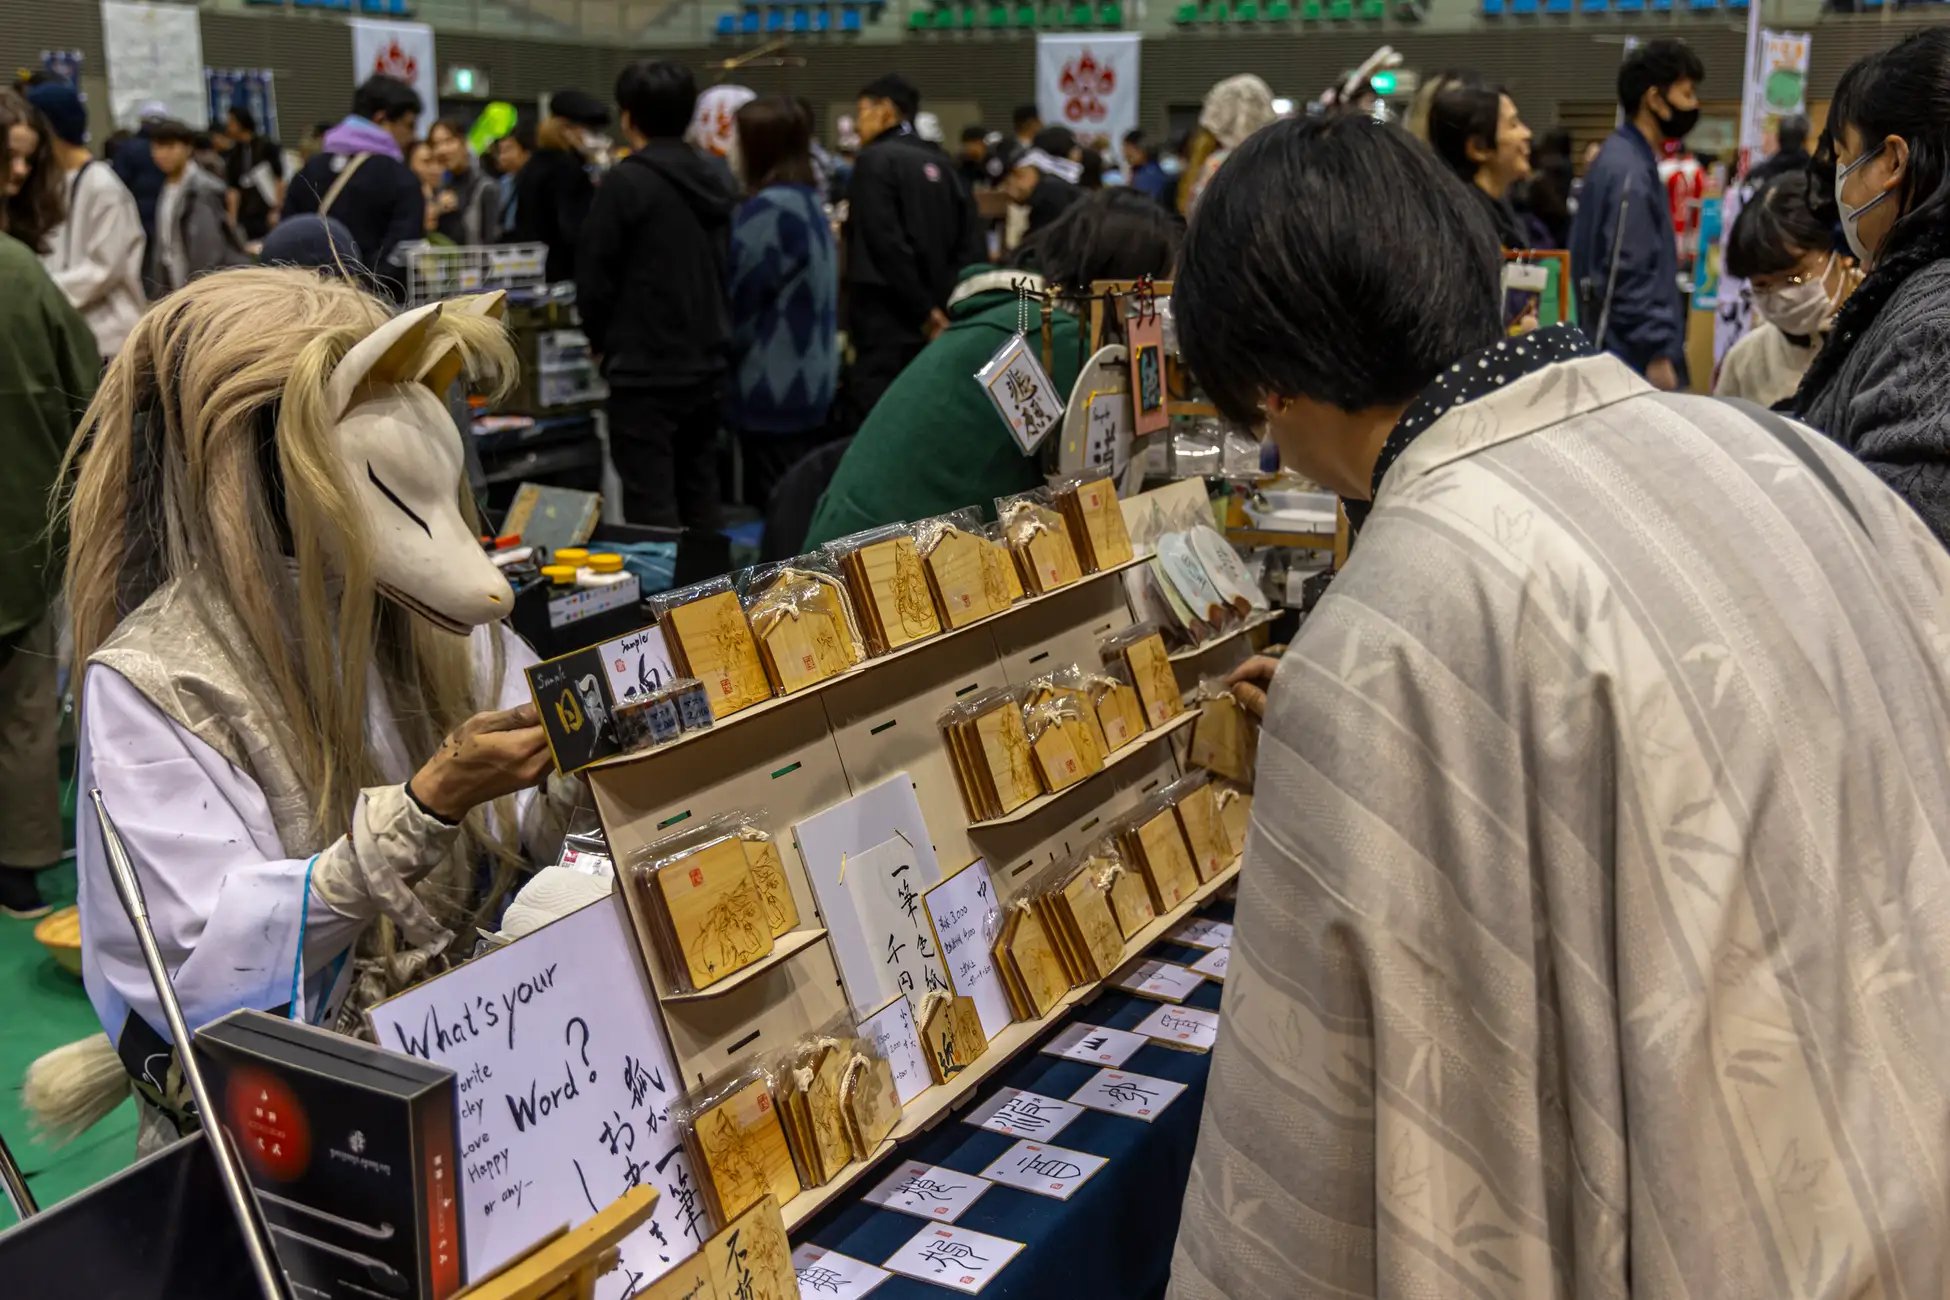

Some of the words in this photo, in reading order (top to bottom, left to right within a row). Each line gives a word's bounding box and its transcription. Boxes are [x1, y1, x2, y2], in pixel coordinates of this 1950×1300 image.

[393, 997, 499, 1061] What's
[502, 963, 558, 1050] your
[457, 1062, 493, 1092] orite
[459, 1098, 484, 1126] cky
[468, 1147, 509, 1184] Happy
[484, 1201, 497, 1217] or
